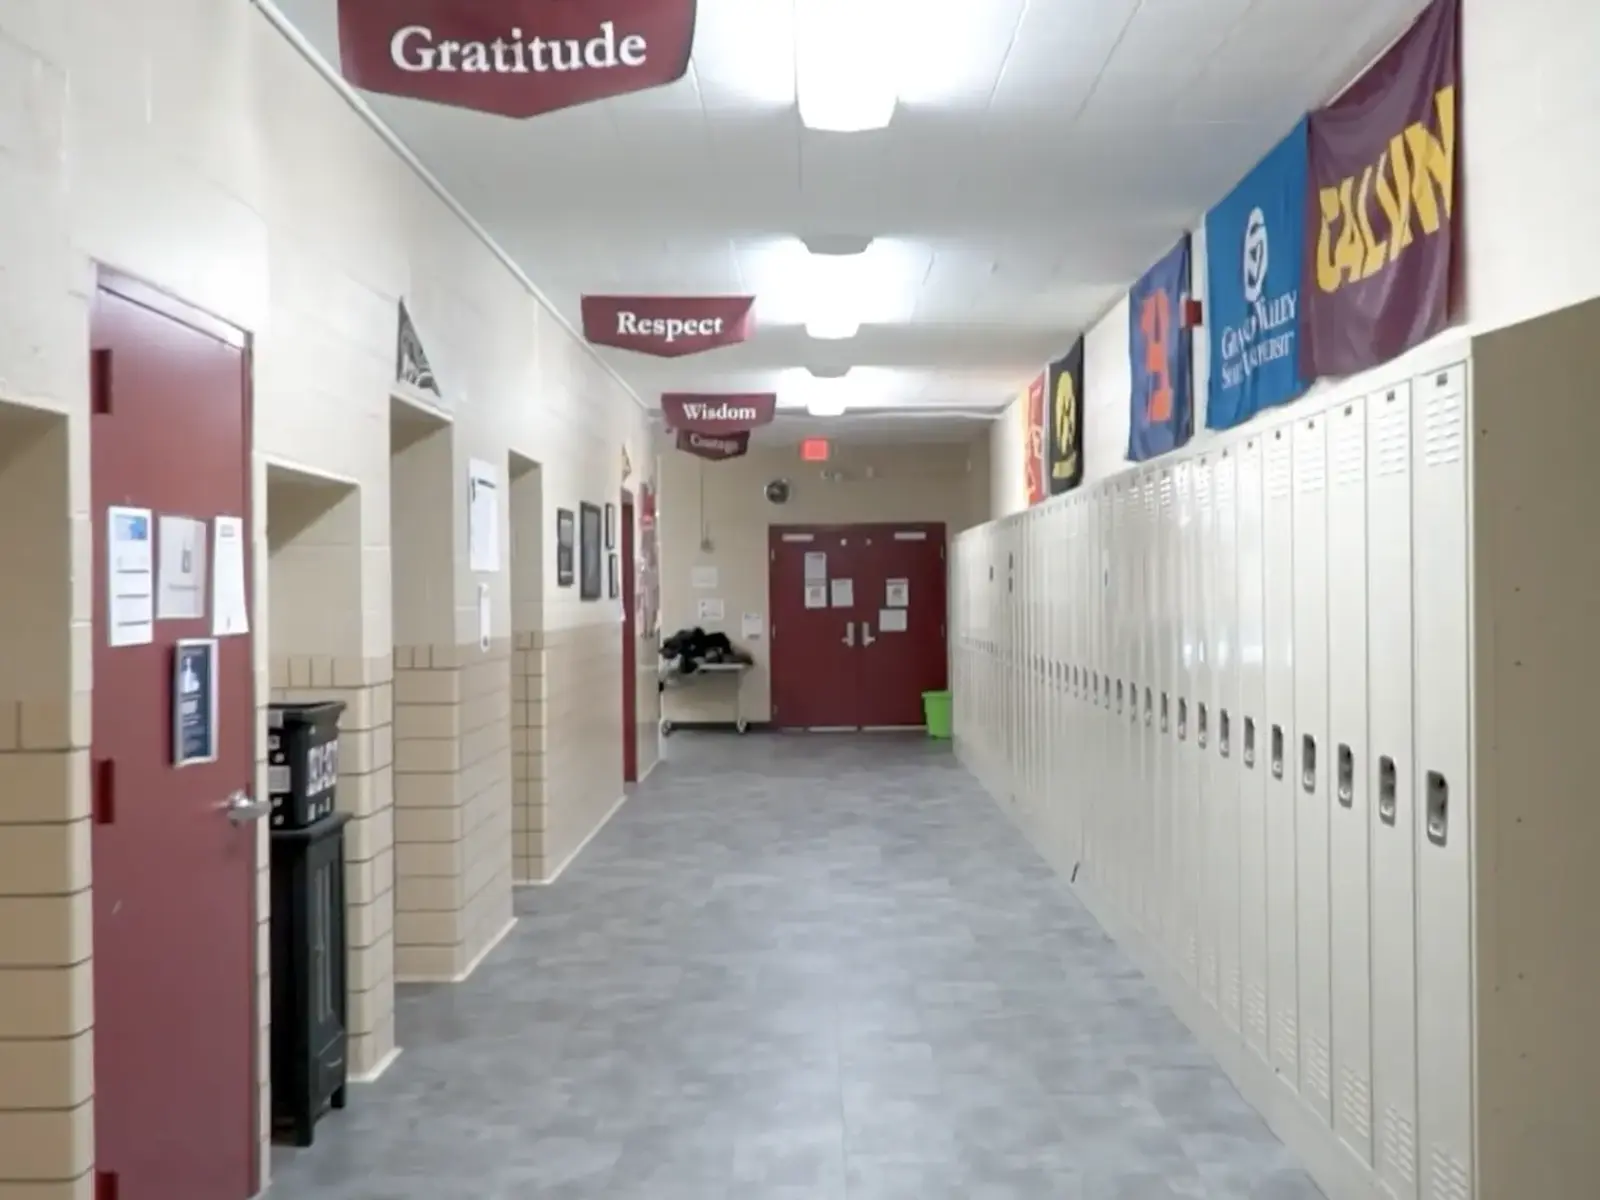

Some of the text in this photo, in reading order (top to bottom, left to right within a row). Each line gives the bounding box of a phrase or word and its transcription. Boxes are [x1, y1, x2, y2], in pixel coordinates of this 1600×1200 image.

[390, 21, 647, 73] Gratitude
[1316, 85, 1454, 293] CALVIN
[616, 311, 724, 342] Respect
[682, 402, 757, 420] Wisdom
